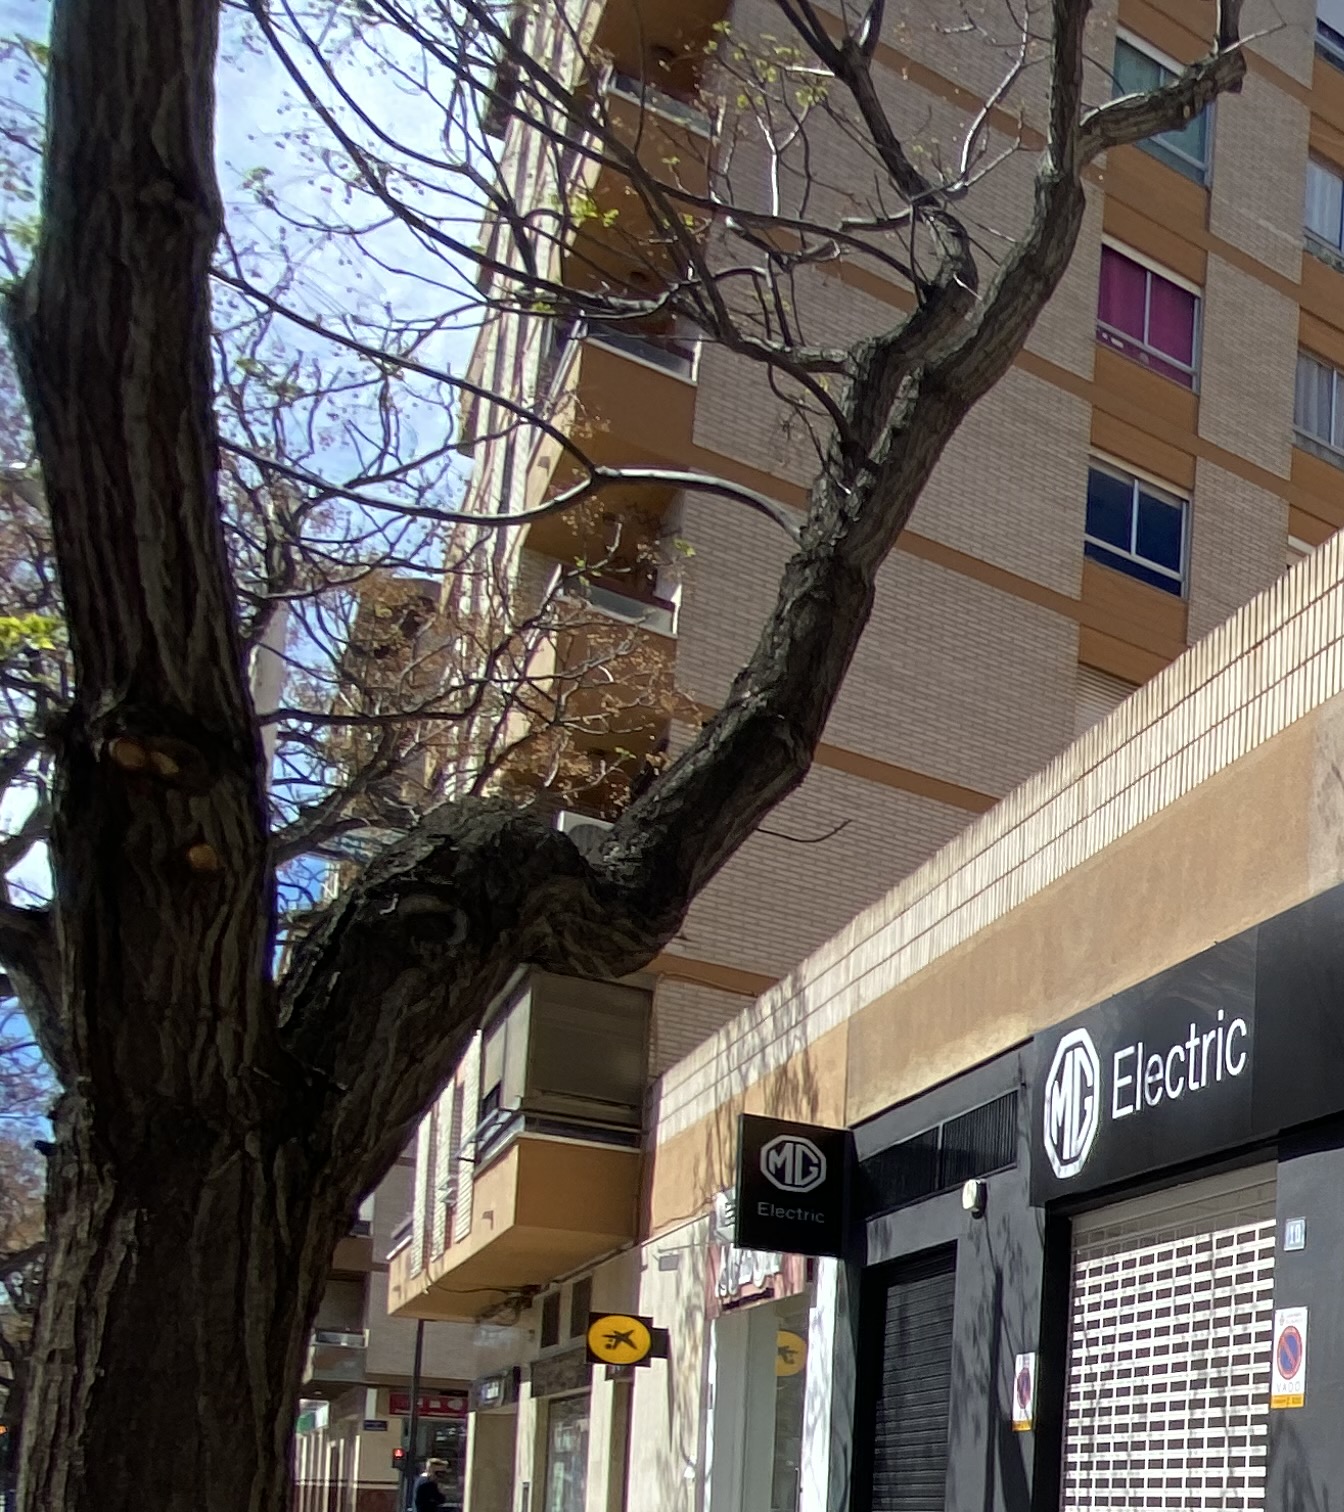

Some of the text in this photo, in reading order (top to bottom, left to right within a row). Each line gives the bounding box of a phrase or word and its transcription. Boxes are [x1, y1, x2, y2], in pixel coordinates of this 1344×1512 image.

[1047, 1009, 1247, 1169] MG Electric
[764, 1138, 823, 1189] MG
[757, 1201, 825, 1224] Electric
